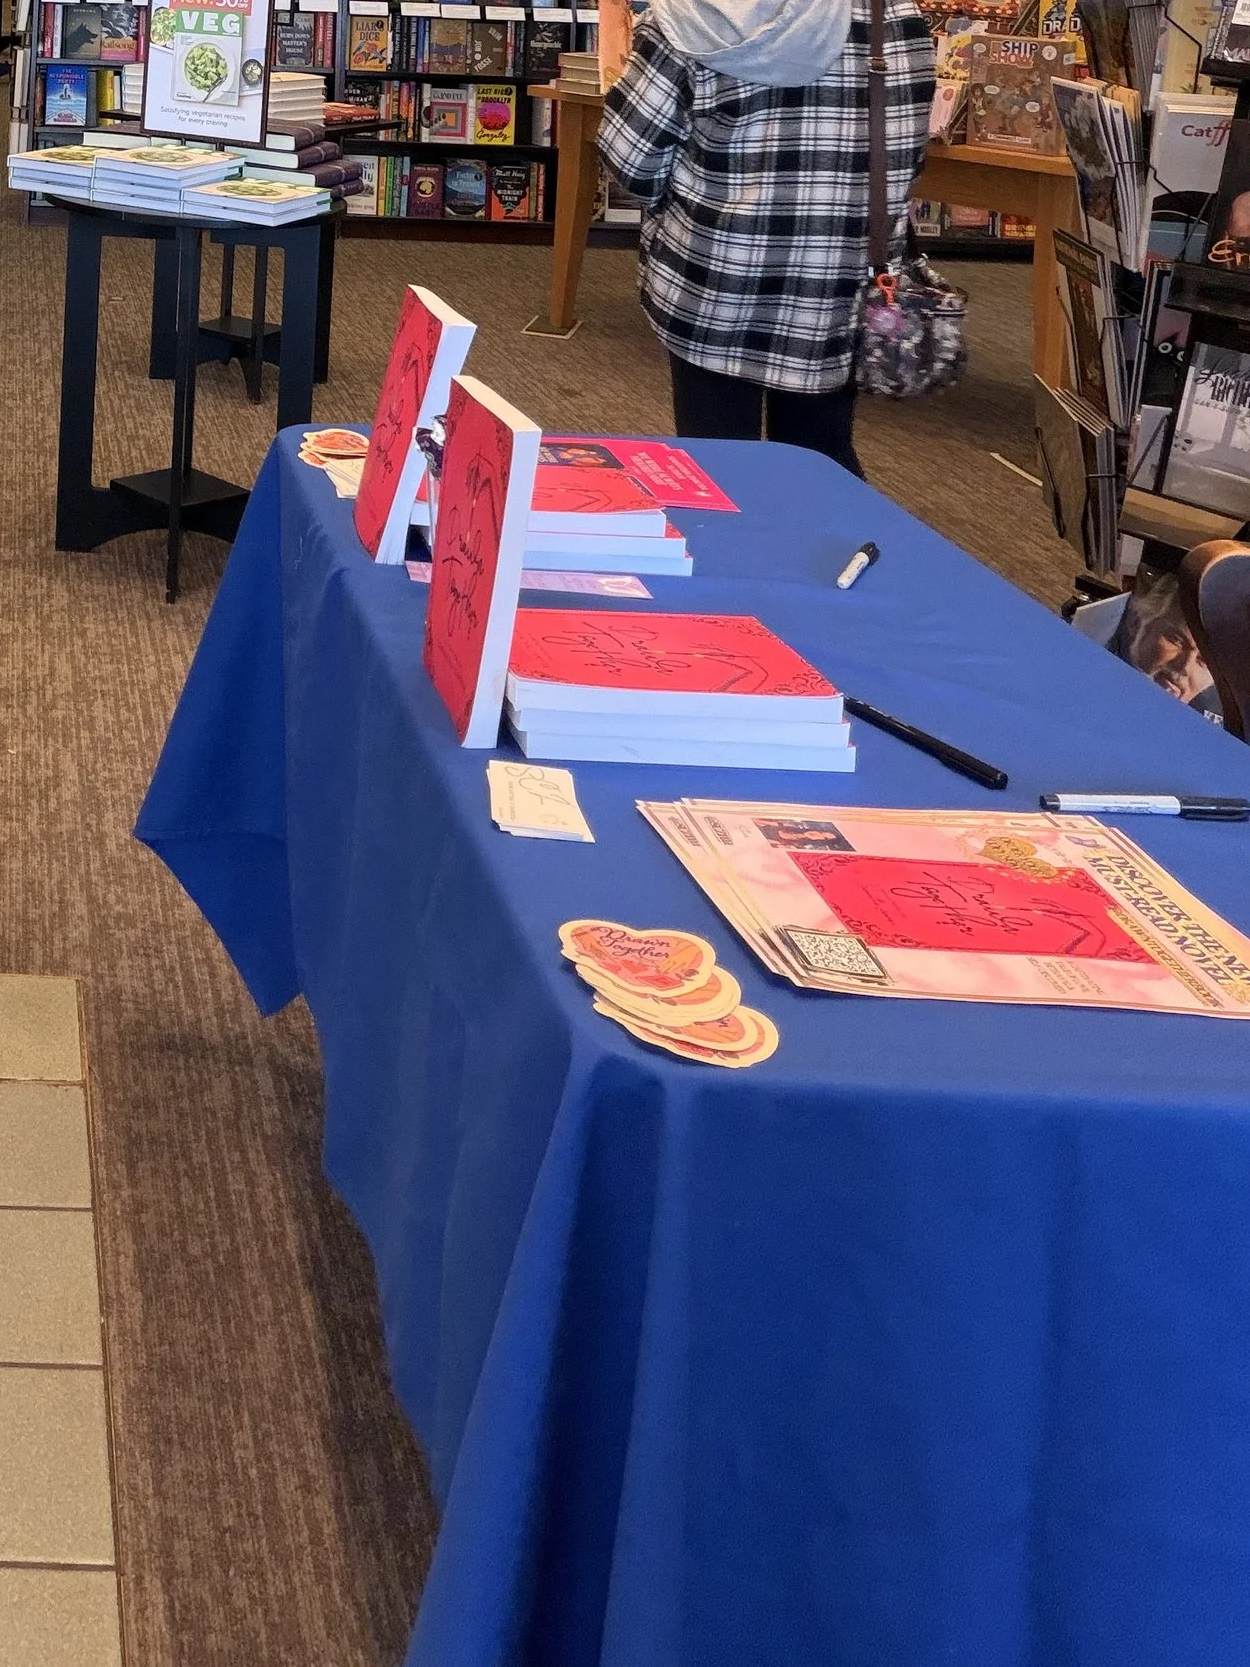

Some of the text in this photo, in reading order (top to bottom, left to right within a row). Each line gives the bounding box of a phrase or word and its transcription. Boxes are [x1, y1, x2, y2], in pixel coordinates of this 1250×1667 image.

[181, 10, 241, 34] VEG
[359, 31, 380, 41] DICE
[1002, 41, 1039, 54] SHIP
[990, 53, 1034, 67] SHOW
[160, 106, 246, 122] Satisfying vegetarian recipes
[188, 117, 206, 125] every
[206, 120, 228, 128] craving
[1107, 855, 1231, 959] DISCOVER THE
[591, 926, 670, 948] Drawn
[597, 938, 670, 959] Together
[1170, 935, 1235, 985] NOVEL
